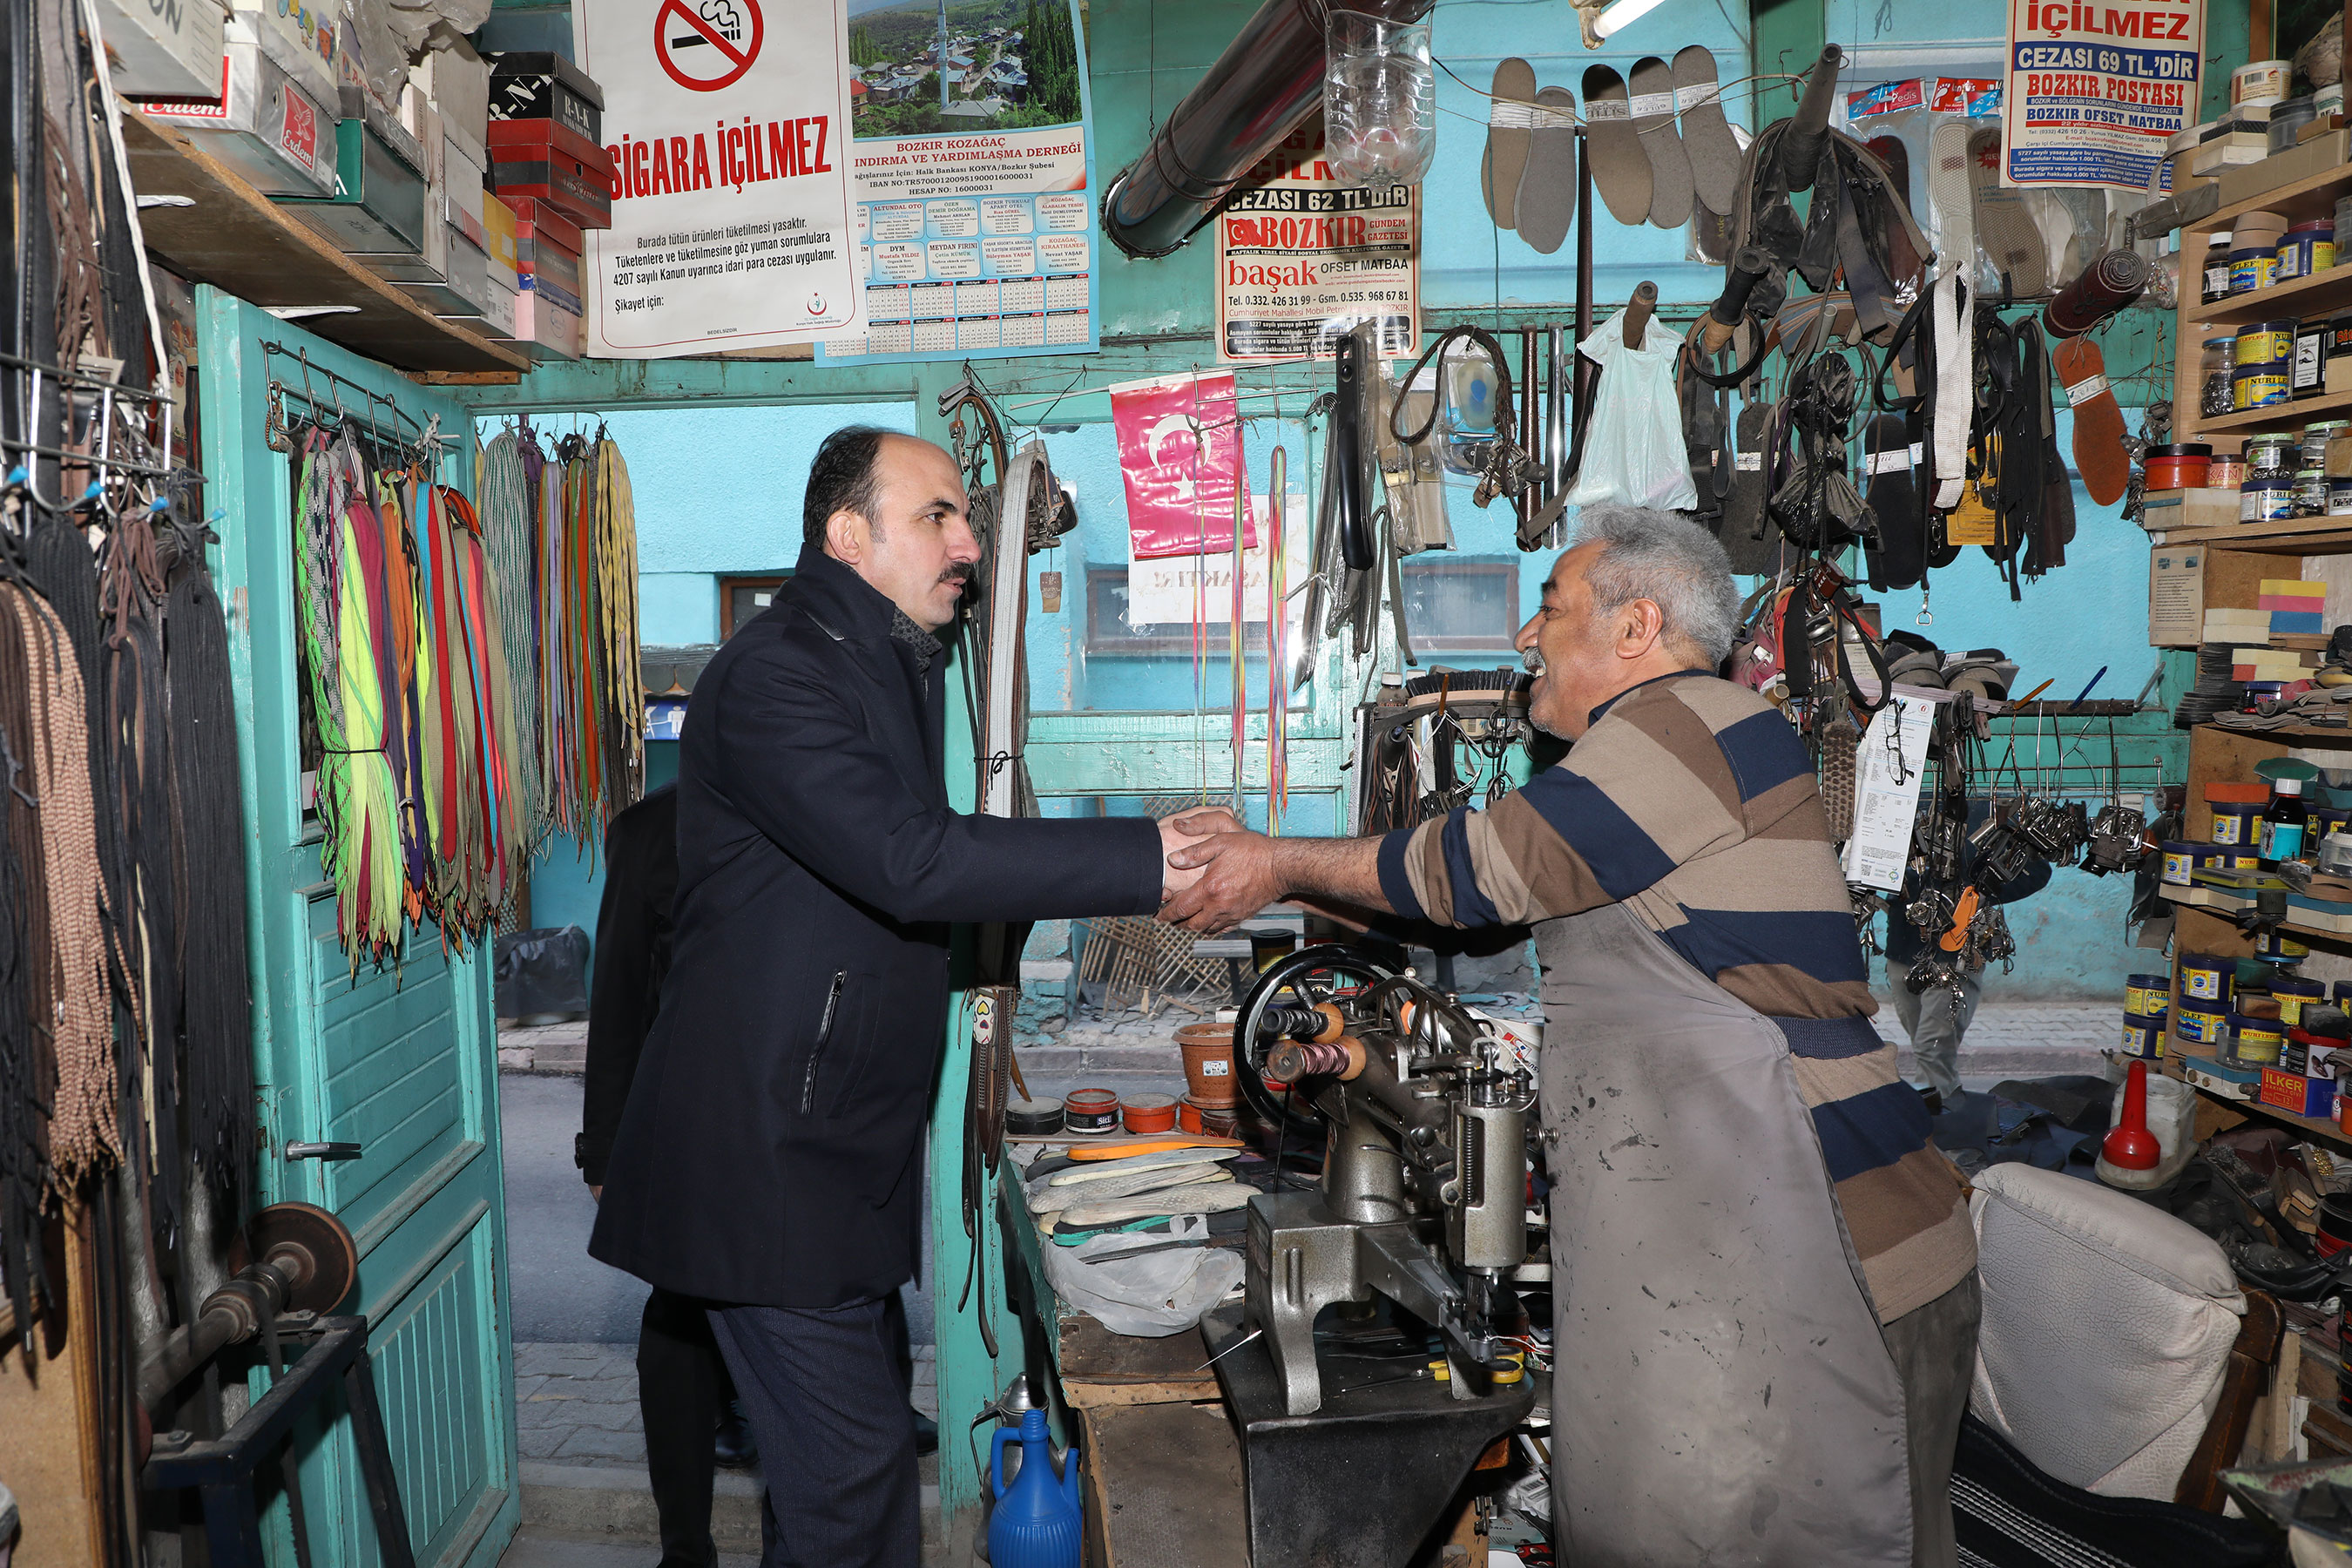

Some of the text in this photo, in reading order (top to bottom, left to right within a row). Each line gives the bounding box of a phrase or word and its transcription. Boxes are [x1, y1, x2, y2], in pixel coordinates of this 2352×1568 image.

[2017, 47, 2092, 70] CEZASI
[2099, 51, 2120, 72] 69
[2027, 74, 2185, 106] BOZKIR POSTASI
[2027, 108, 2182, 130] BOZKIR OFSET MATBAA
[283, 129, 313, 166] Erdem
[855, 141, 1082, 167] INDIRMA VE YARDIMLAŞMA DERNEĞİ
[896, 136, 1006, 152] BOZKIR KOZAĞAÇ
[605, 116, 832, 200] SİGARA İÇİLMEZ
[855, 160, 1055, 180] ağışlarınız İçin: Halk Bankası KONYA/Bozkır Şubesi
[909, 186, 936, 195] HESAP
[955, 184, 994, 193] 16000031
[1228, 186, 1408, 211] CEZASI 62 TL'DİR
[637, 218, 808, 249] Burada tütün ürünleri tüketilmesi yasaktır.
[1260, 216, 1367, 249] BOZKIR
[1369, 218, 1406, 230] GÜNDEM
[1368, 230, 1409, 241] GAZETESİ
[615, 232, 830, 269] Tüketenlere ve tüketilmesine göz yuman sorumlulara
[1320, 247, 1351, 256] EKONOMİK
[613, 249, 836, 287] 4207 sayılı Kanun uyarınca idari para cezası uygulanır.
[1228, 260, 1319, 294] başak
[1321, 260, 1358, 274] OFSET
[1361, 258, 1409, 271] MATBAA
[615, 294, 665, 314] Şikayet için:
[1228, 296, 1243, 306] Tel.
[1246, 296, 1269, 306] 0.332.
[1272, 296, 1286, 307] 426
[1288, 296, 1298, 306] 31
[1301, 295, 1311, 305] 99
[1318, 294, 1339, 304] Gsm.
[1341, 292, 1366, 302] 0.535.
[1369, 291, 1383, 301] 968
[1386, 291, 1396, 301] 67
[1398, 291, 1409, 301] 81
[1228, 309, 1269, 318] Cumhuriyet
[1271, 308, 1304, 317] Mahallesi
[1306, 307, 1324, 315] Mobil
[1327, 306, 1347, 314] Petrol
[707, 327, 738, 335] BEDELSİZDİR
[2266, 1071, 2302, 1092] İLKER
